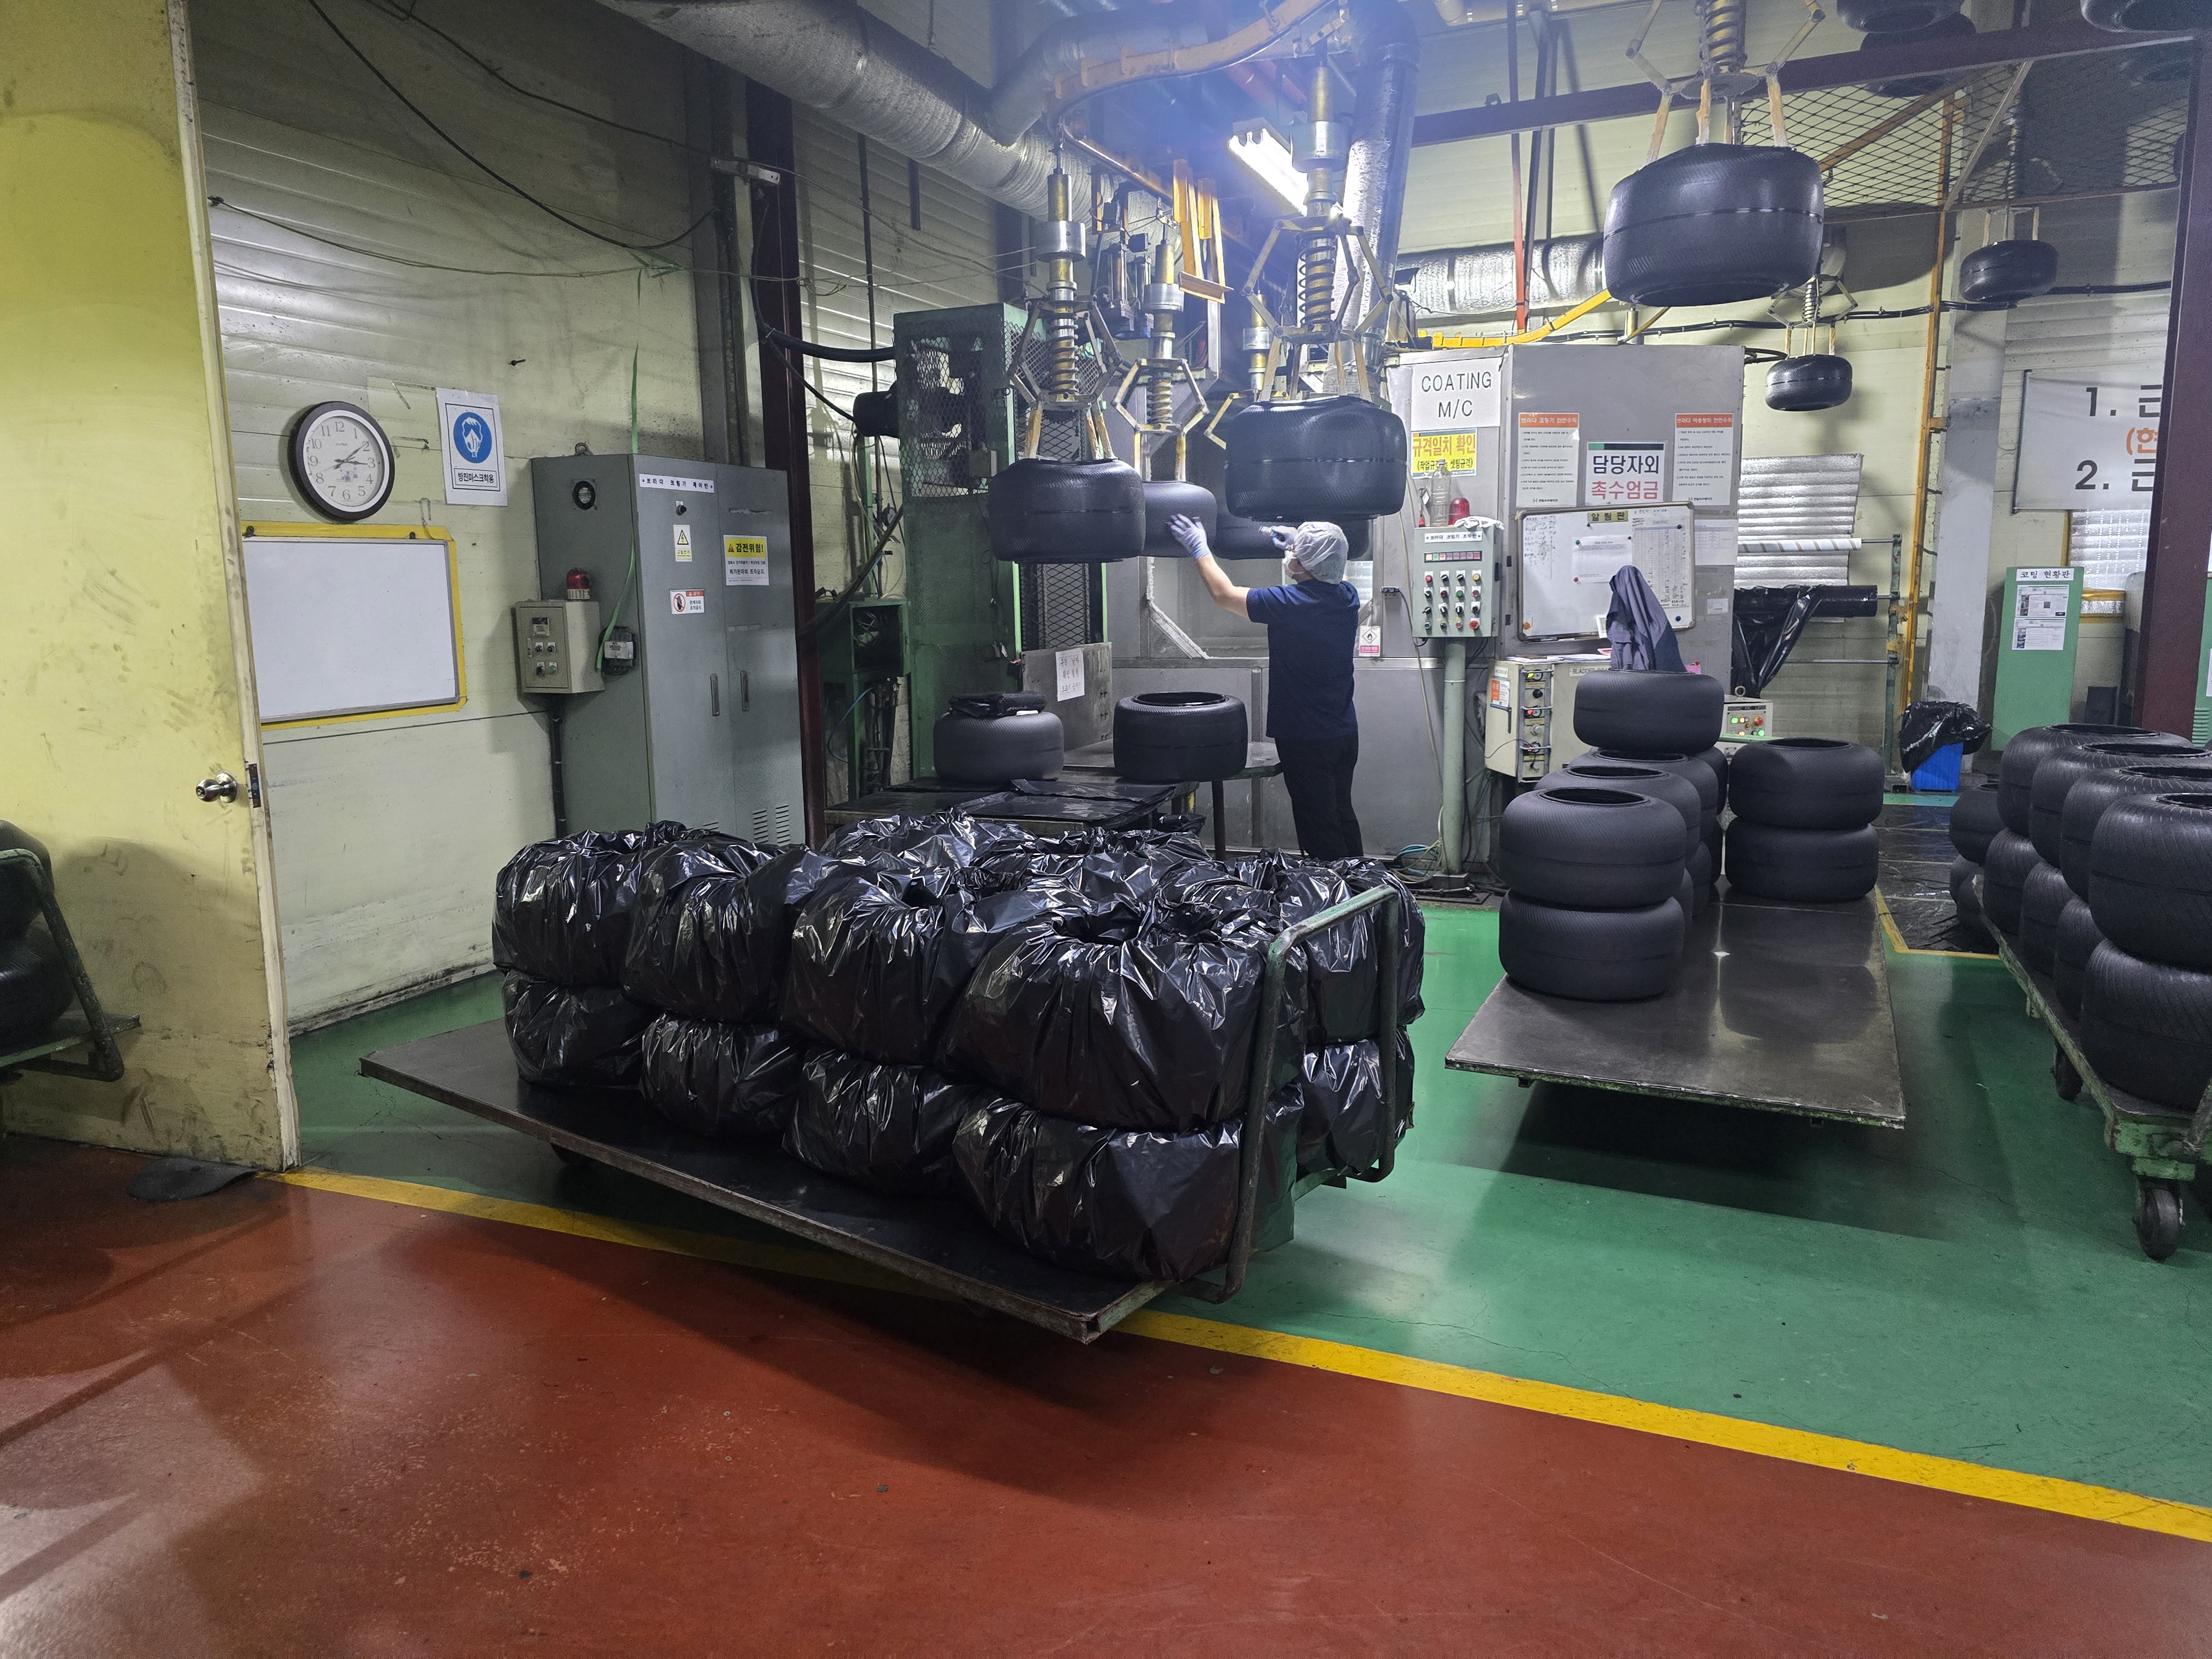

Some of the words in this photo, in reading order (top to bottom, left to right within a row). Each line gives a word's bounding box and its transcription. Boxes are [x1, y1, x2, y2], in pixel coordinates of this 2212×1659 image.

[1421, 371, 1491, 392] COATING
[2086, 387, 2117, 416] 1.
[1438, 399, 1473, 419] M/C
[321, 425, 331, 436] 11
[335, 421, 345, 432] 12
[353, 427, 358, 439] 1
[311, 438, 322, 450] 10
[362, 440, 370, 452] 2
[1412, 435, 1452, 457] 규격일치
[1457, 434, 1476, 455] 확인
[309, 455, 319, 467] 9
[367, 457, 376, 469] 3
[1451, 457, 1473, 469] 셋팅규격)
[1593, 455, 1659, 474] 담당자외
[315, 472, 325, 484] 8
[366, 473, 374, 484] 4
[458, 472, 494, 484] 방진마스크착용
[2075, 460, 2109, 490] 2.
[328, 486, 336, 497] 7
[342, 489, 351, 500] 6
[358, 486, 366, 497] 5
[1591, 481, 1658, 500] 촉수엄금
[735, 542, 764, 553] 감전위험!
[2020, 570, 2038, 579] 코팅
[2043, 570, 2070, 578] 현황판
